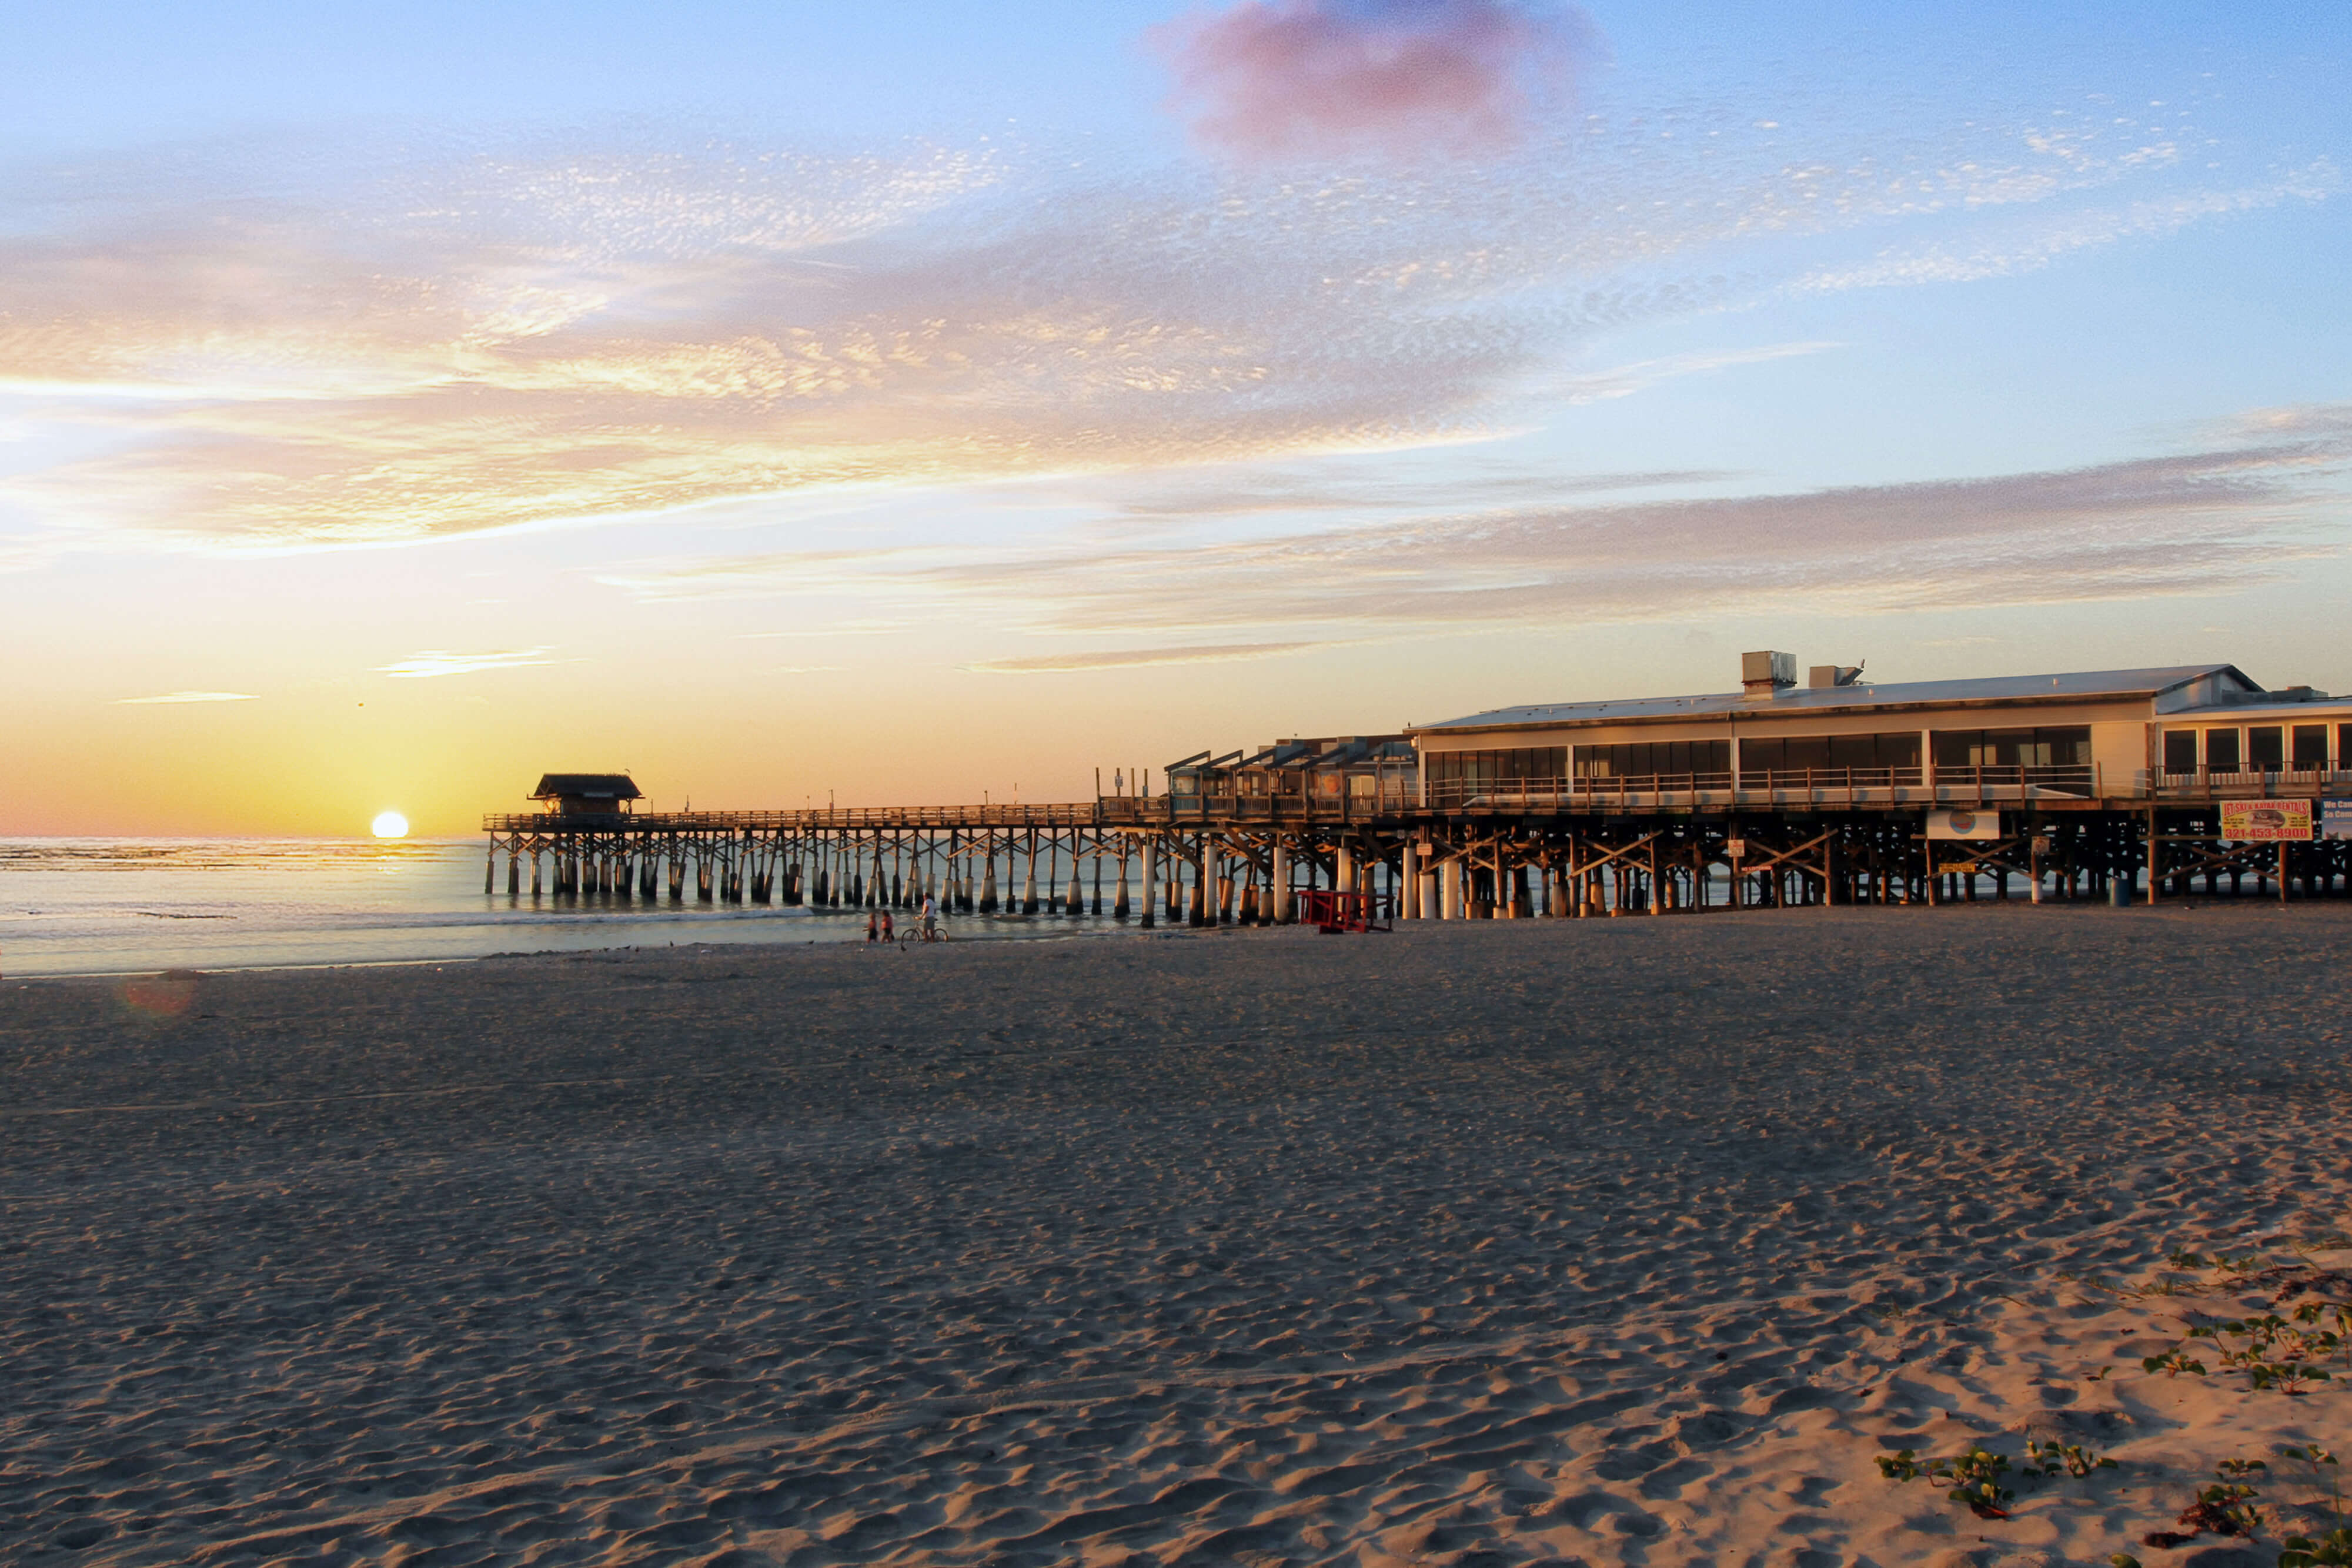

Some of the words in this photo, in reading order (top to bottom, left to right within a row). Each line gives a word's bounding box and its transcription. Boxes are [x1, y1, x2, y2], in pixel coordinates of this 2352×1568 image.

[2224, 803, 2234, 816] JET
[2235, 802, 2247, 813] SKI
[2277, 802, 2307, 815] RENTALS
[2323, 810, 2334, 818] So
[2225, 828, 2308, 838] 321-453-8900
